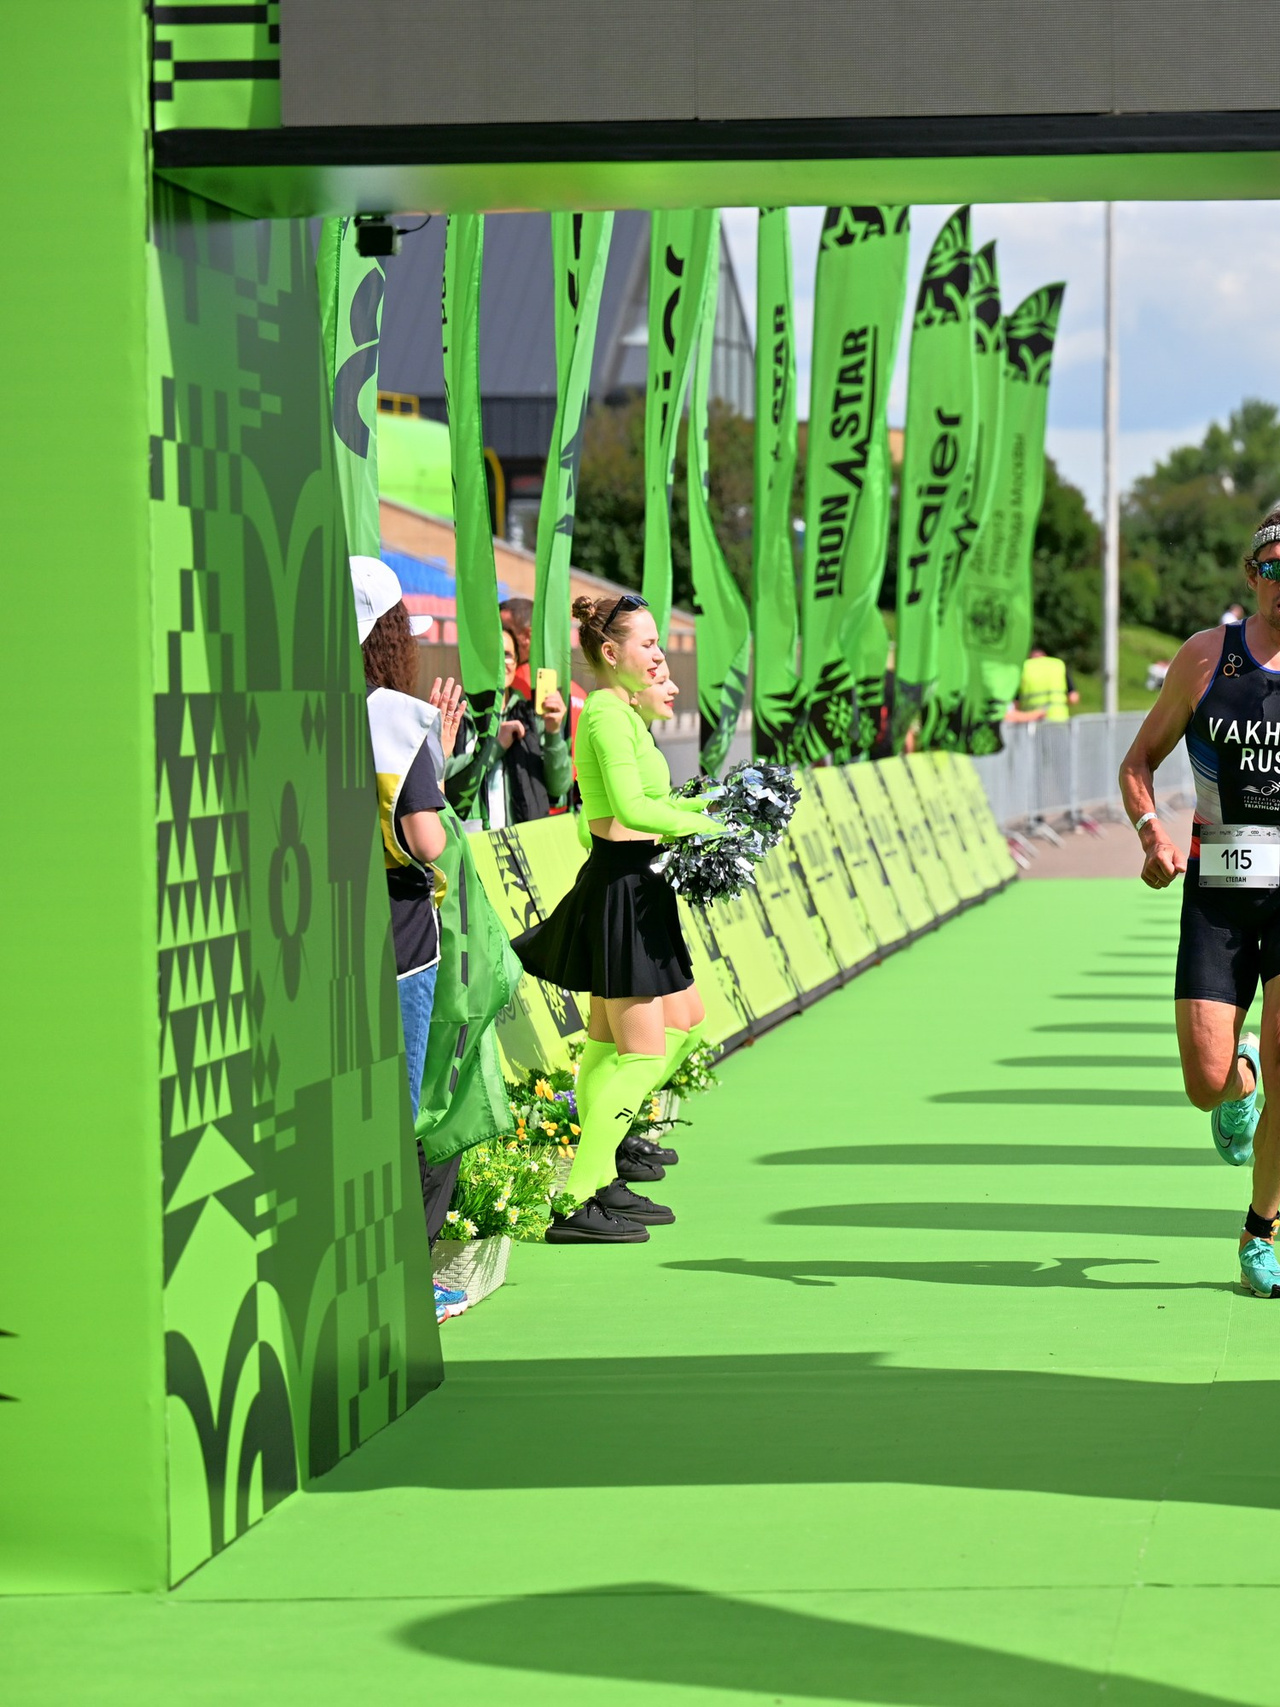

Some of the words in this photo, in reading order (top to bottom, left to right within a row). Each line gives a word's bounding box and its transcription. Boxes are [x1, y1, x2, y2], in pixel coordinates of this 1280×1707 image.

[831, 325, 868, 440] STAR
[814, 492, 849, 601] IRON
[907, 406, 962, 605] Haier
[1221, 849, 1253, 870] 115
[1244, 803, 1280, 811] TRIATHLON
